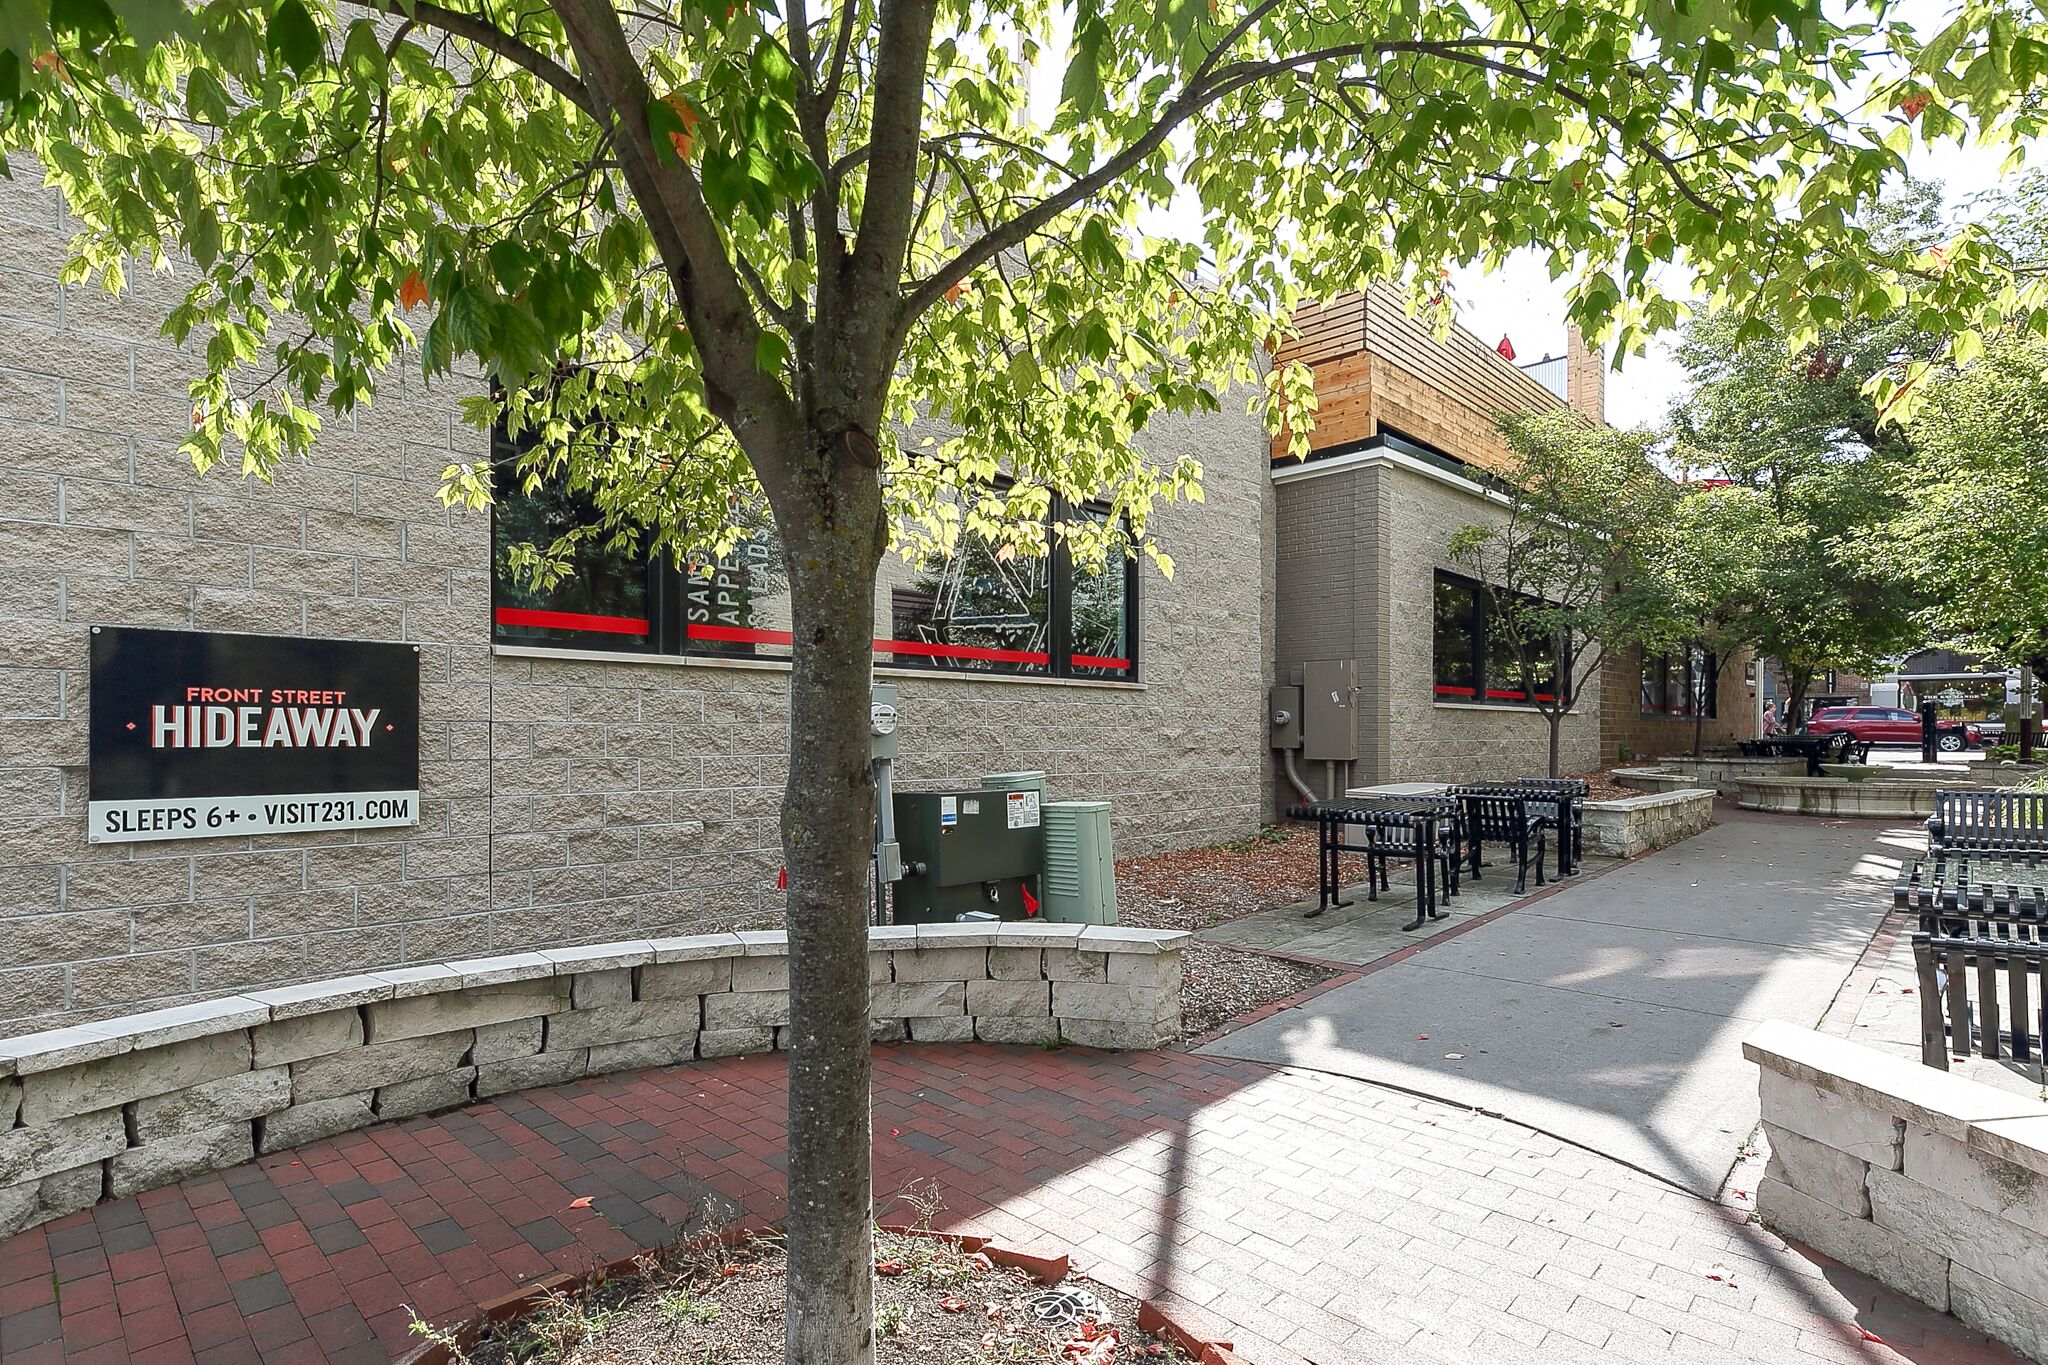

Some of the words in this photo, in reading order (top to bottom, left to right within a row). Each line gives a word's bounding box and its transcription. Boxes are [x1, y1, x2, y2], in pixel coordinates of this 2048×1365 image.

[186, 687, 263, 703] FRONT
[270, 689, 346, 705] STREET
[151, 704, 381, 749] HIDEAWAY
[105, 806, 197, 834] SLEEPS
[206, 805, 240, 830] 6+
[263, 799, 409, 826] VISIT231.COM
